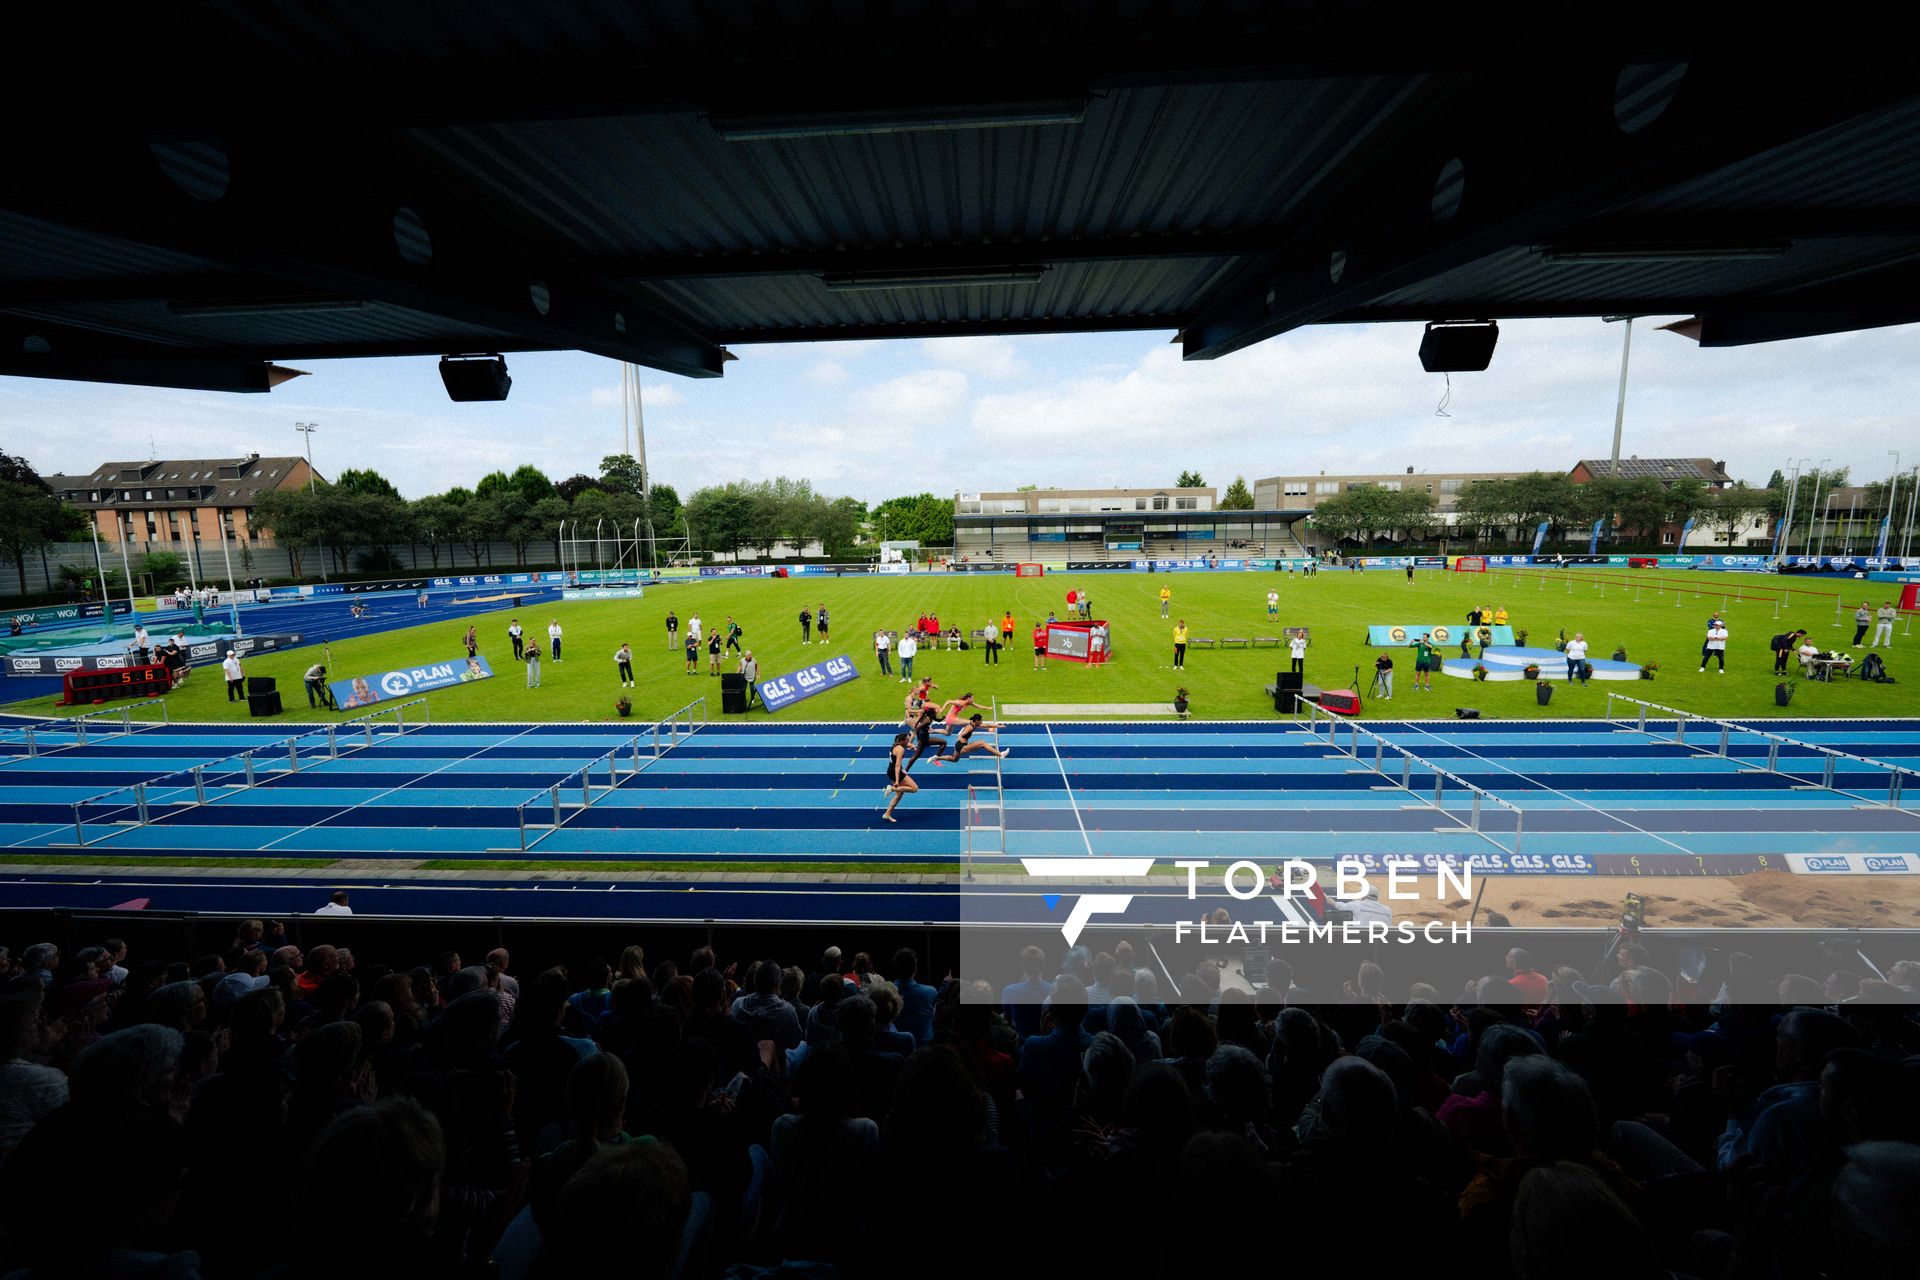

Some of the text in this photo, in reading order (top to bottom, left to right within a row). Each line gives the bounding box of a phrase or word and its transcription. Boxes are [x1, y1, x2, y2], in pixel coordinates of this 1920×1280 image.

[57, 609, 78, 618] WGV
[201, 643, 216, 651] PLAN
[411, 664, 454, 682] PLAN
[418, 676, 457, 688] INTERNATIONAL
[1630, 856, 1640, 867] 6
[1695, 856, 1704, 867] 7
[1759, 855, 1768, 866] 8
[1822, 859, 1848, 867] PLAN
[1881, 859, 1906, 867] PLAN
